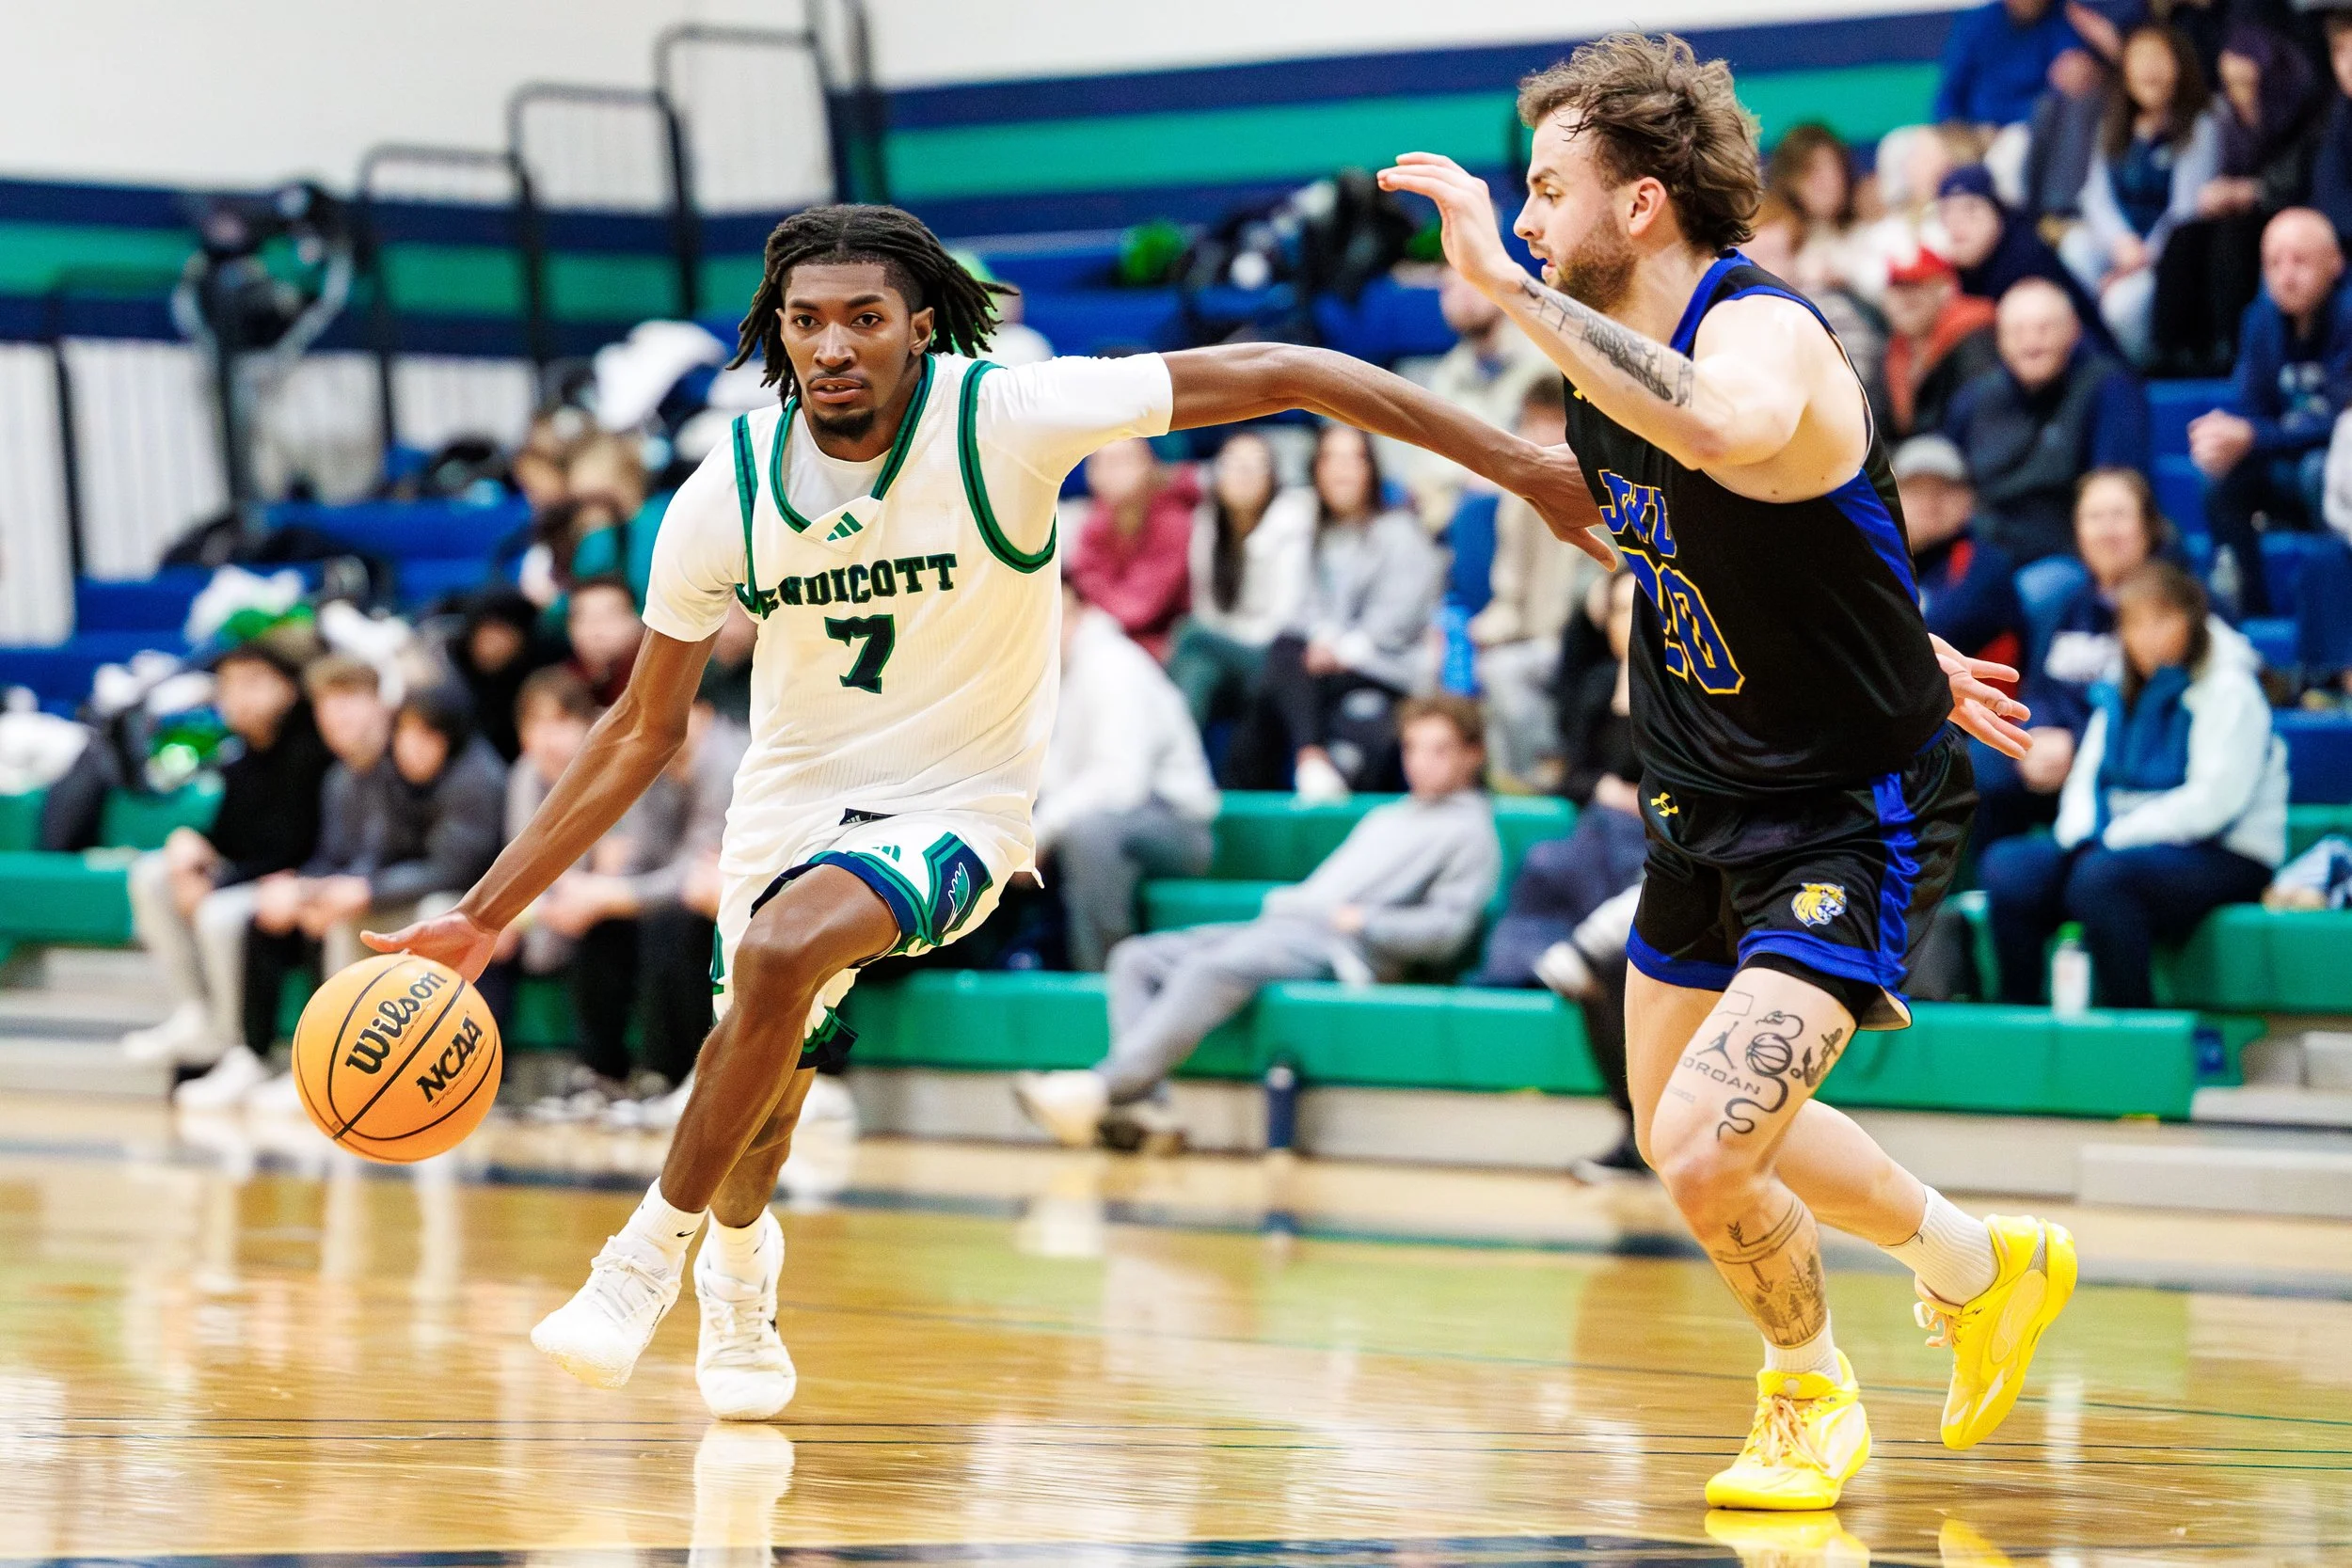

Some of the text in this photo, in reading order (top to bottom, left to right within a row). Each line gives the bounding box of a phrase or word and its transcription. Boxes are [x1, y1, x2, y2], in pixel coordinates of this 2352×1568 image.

[824, 613, 895, 695] 7
[344, 971, 448, 1075] Wilson
[415, 1016, 484, 1103] NCAA
[1677, 1055, 1761, 1096] ORDAN
